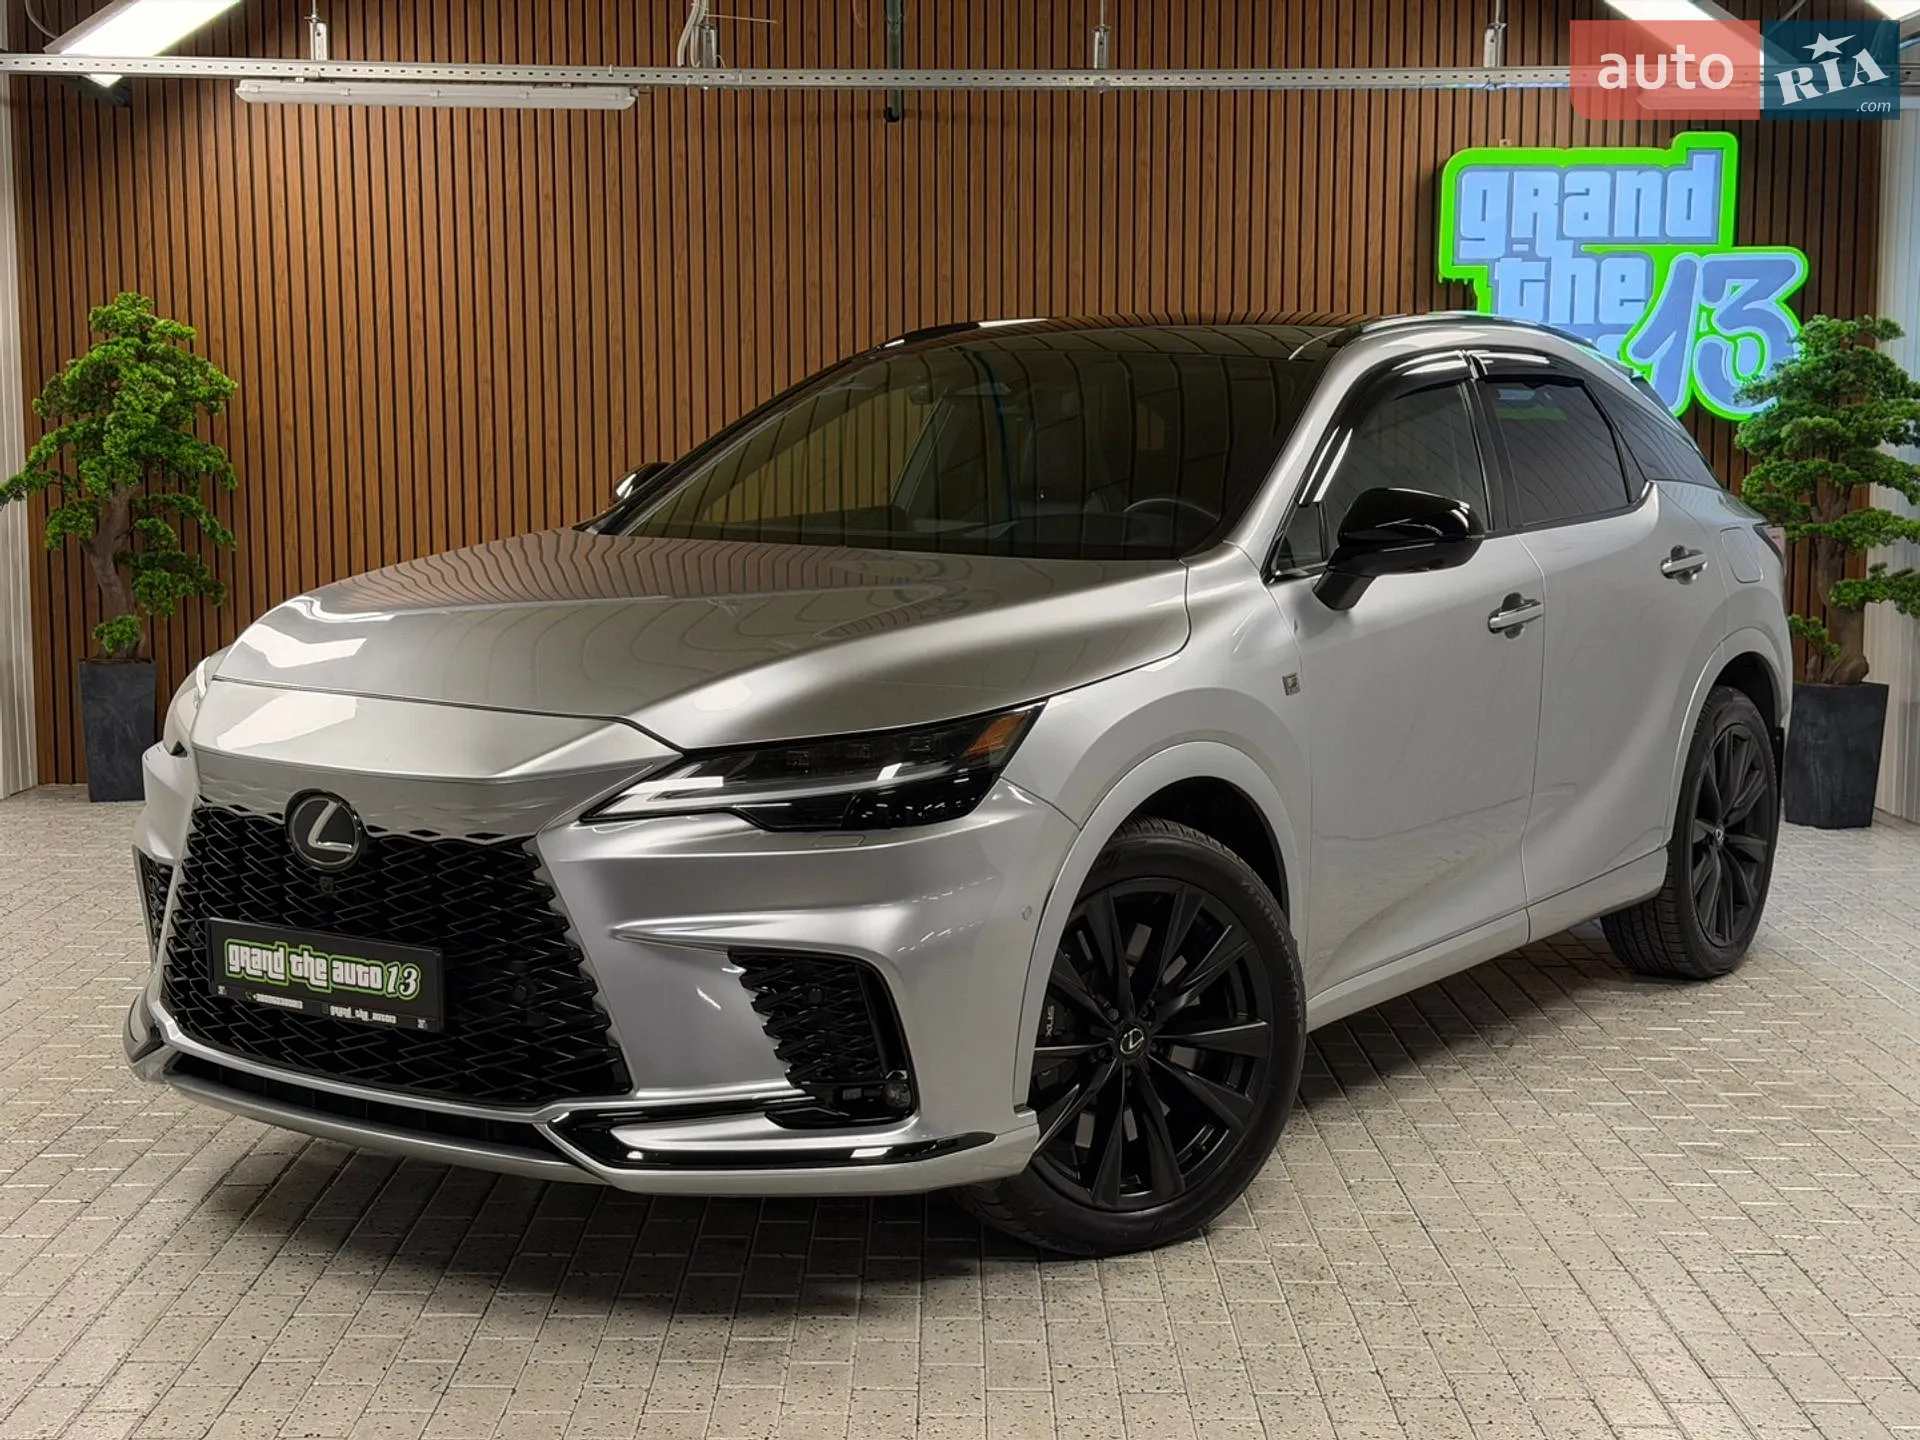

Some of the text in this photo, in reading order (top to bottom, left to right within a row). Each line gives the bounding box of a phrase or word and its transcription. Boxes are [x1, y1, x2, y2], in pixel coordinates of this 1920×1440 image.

[1494, 239, 1648, 325] the
[1627, 251, 1797, 410] 13
[290, 951, 328, 987] the
[332, 960, 383, 990] auto
[387, 966, 418, 996] 13
